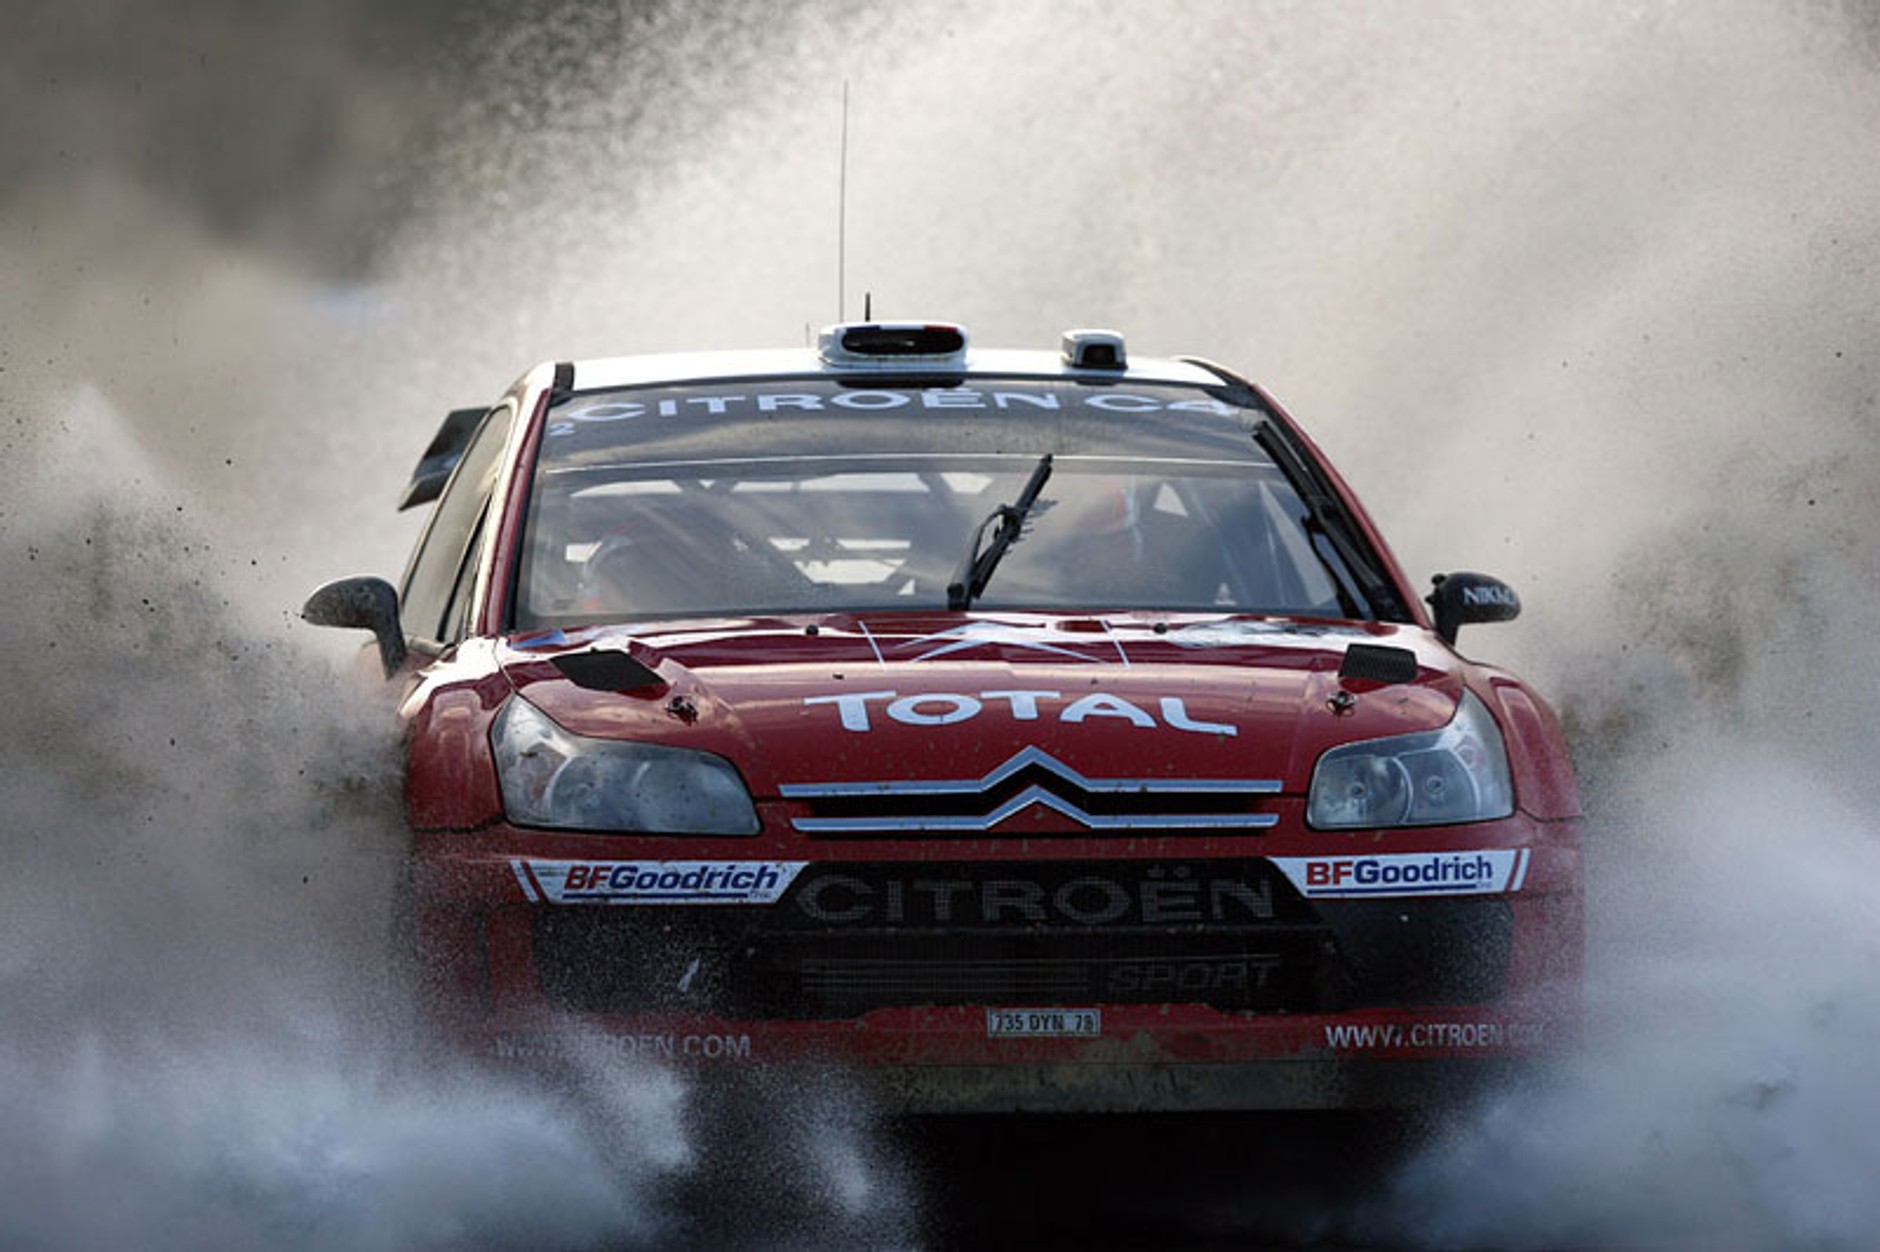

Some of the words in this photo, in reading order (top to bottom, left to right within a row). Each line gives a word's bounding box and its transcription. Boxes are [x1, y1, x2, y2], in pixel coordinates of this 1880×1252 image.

[804, 690, 1237, 736] TOTAL
[564, 865, 779, 890] BFGoodrich
[1306, 856, 1493, 886] BFGoodrich
[799, 864, 1274, 924] CITROËN
[1108, 962, 1280, 991] SPORT
[994, 1014, 1024, 1031] 735
